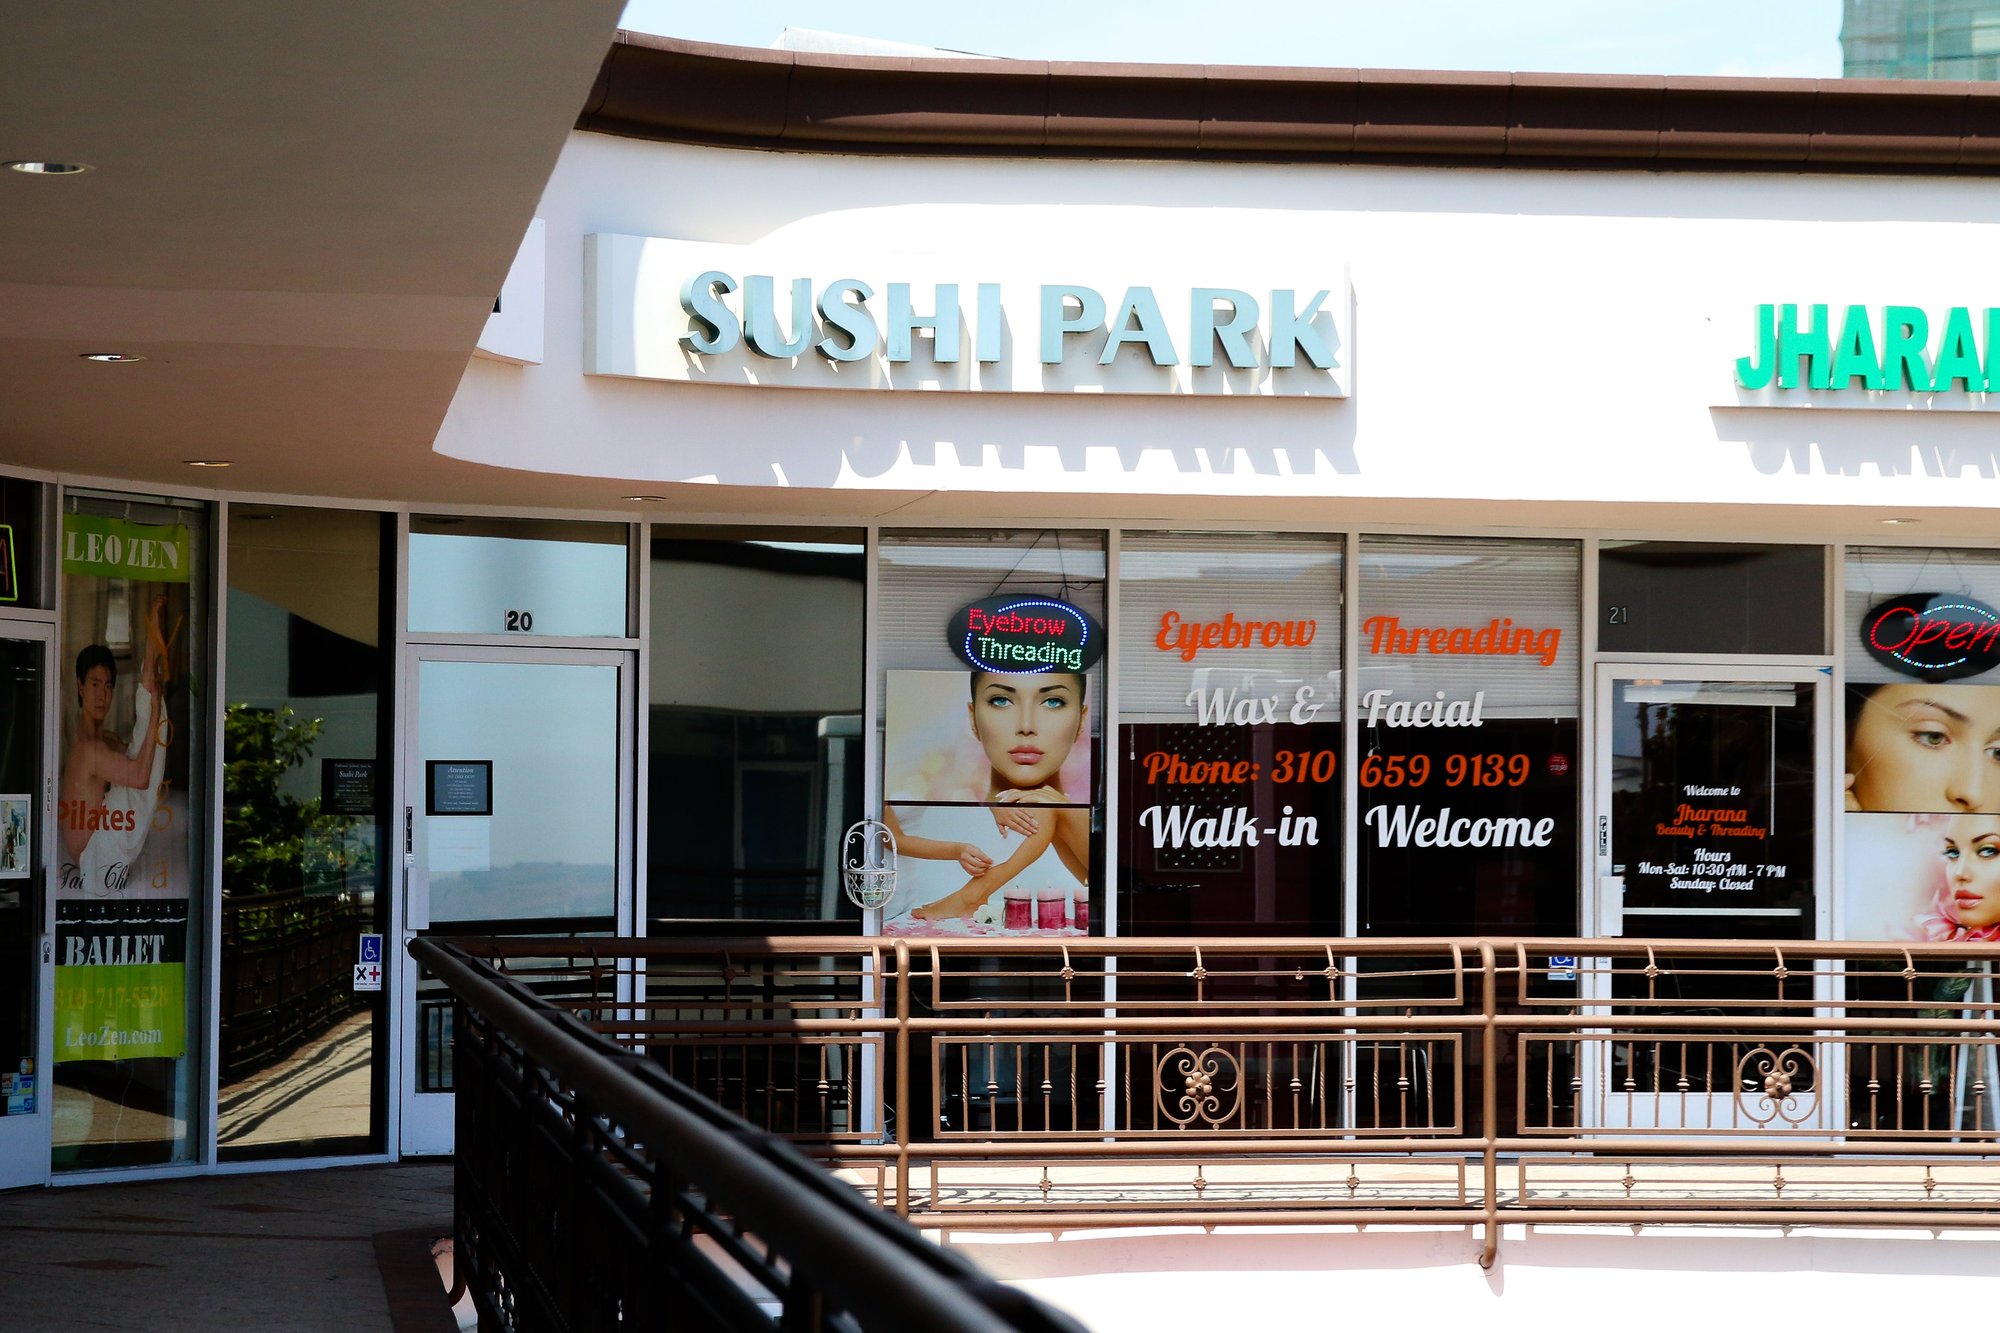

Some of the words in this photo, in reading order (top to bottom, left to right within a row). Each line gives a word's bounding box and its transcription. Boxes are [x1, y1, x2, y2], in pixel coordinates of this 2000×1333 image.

[678, 271, 1001, 363] SUSHI
[1038, 284, 1341, 370] PARK
[64, 531, 122, 565] LEO
[127, 538, 180, 569] ZEN
[506, 609, 534, 632] 20
[968, 608, 1066, 637] Eyebrow
[1608, 605, 1629, 625] 21
[1155, 611, 1317, 662] Eyebrow
[1363, 616, 1562, 667] Threading
[1869, 606, 2000, 656] Open
[978, 637, 1083, 670] Threading
[1185, 687, 1280, 727] Wax
[1290, 685, 1324, 725] &
[1362, 689, 1485, 728] Facial
[1143, 751, 1261, 785] Phone:
[1271, 750, 1336, 783] 310
[1360, 753, 1431, 788] 659
[1445, 753, 1530, 788] 9139
[1683, 784, 1728, 796] Welcome
[1730, 784, 1740, 796] to
[57, 800, 136, 832] Pilates
[1139, 805, 1320, 849] Walk-in
[1365, 804, 1555, 848] Welcome
[1673, 803, 1747, 824] Jharana
[1656, 823, 1694, 838] Beauty
[1697, 824, 1707, 835] &
[1710, 823, 1766, 839] Threading
[1638, 861, 1689, 875] Mon-Sat:
[1692, 863, 1724, 875] 10:30
[1726, 865, 1746, 876] AM
[1756, 865, 1763, 876] 7
[1766, 865, 1786, 877] PM
[1694, 848, 1731, 862] Hours
[60, 862, 86, 890] Tai
[101, 861, 130, 891] Chi
[1670, 876, 1716, 893] Sunday:
[1719, 879, 1753, 890] Closed
[64, 935, 165, 966] BALLET
[64, 1025, 163, 1047] LeoZen.com
